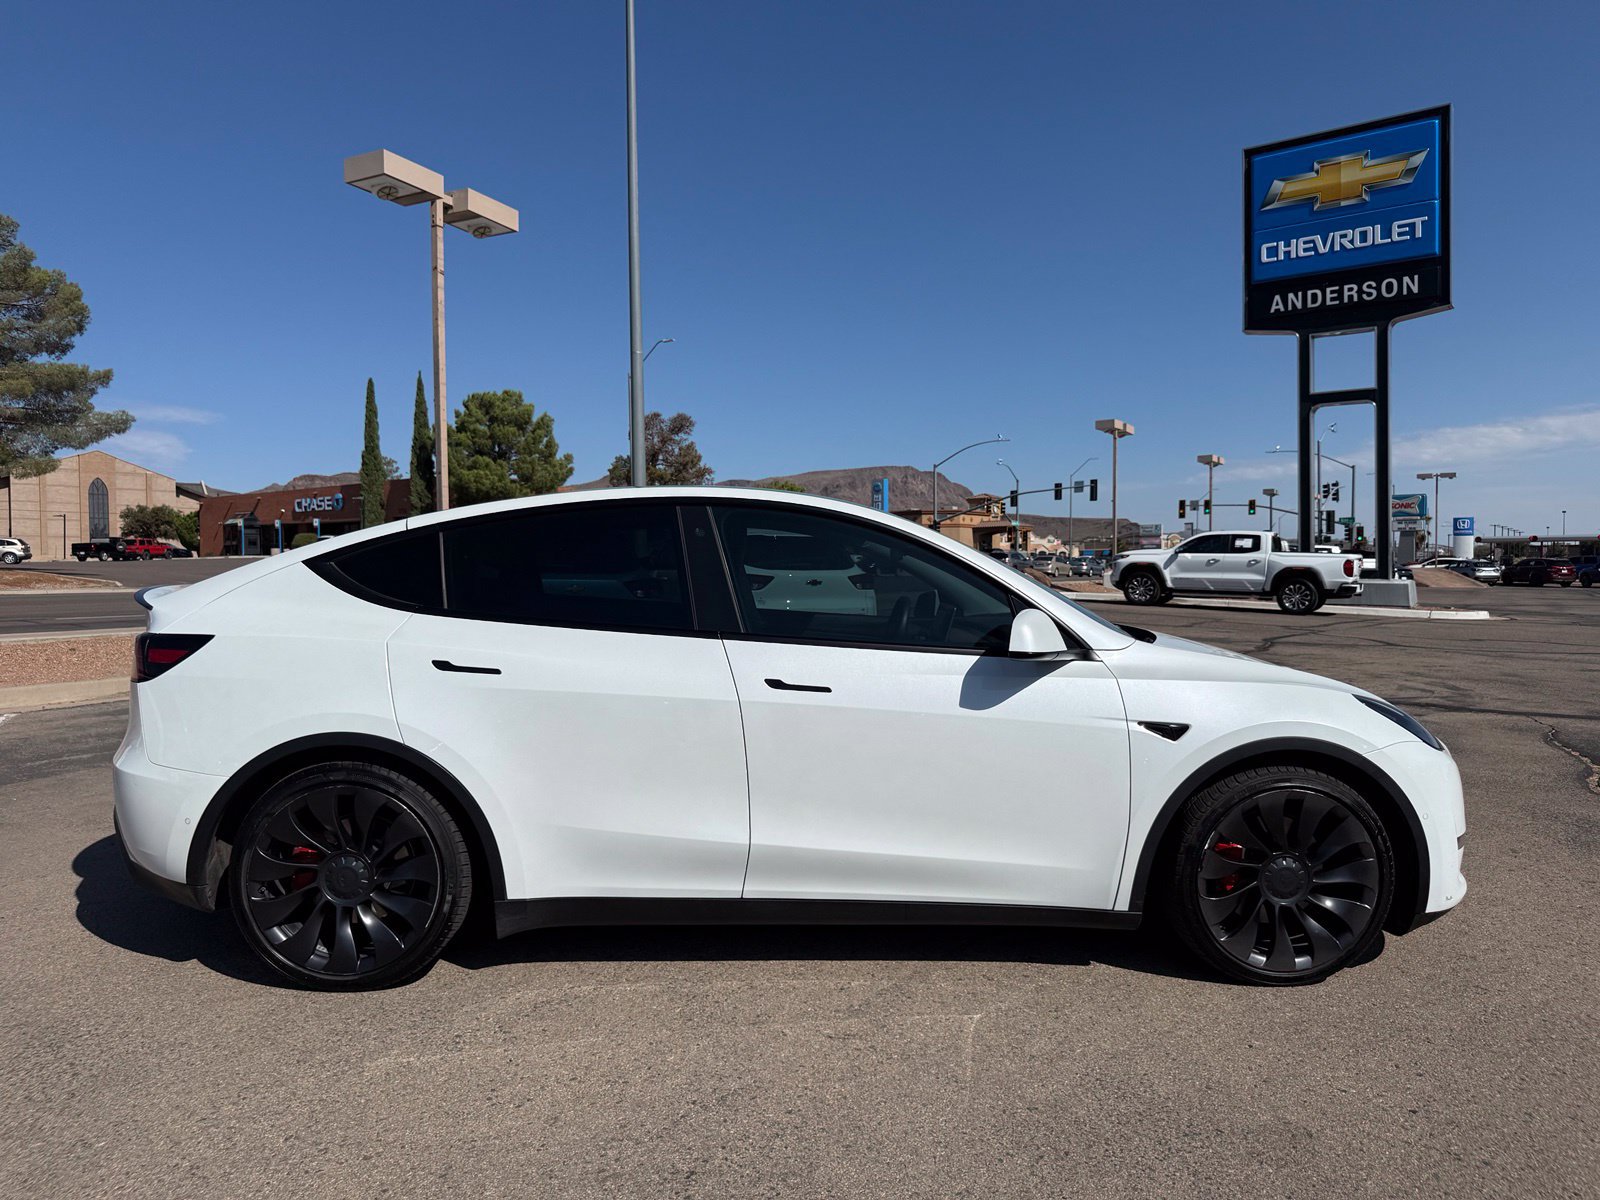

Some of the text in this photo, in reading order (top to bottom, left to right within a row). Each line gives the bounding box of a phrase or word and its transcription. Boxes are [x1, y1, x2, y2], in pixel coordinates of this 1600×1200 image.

[1260, 216, 1428, 263] CHEVROLET
[1269, 274, 1419, 313] ANDERSON
[295, 497, 332, 512] CHASE
